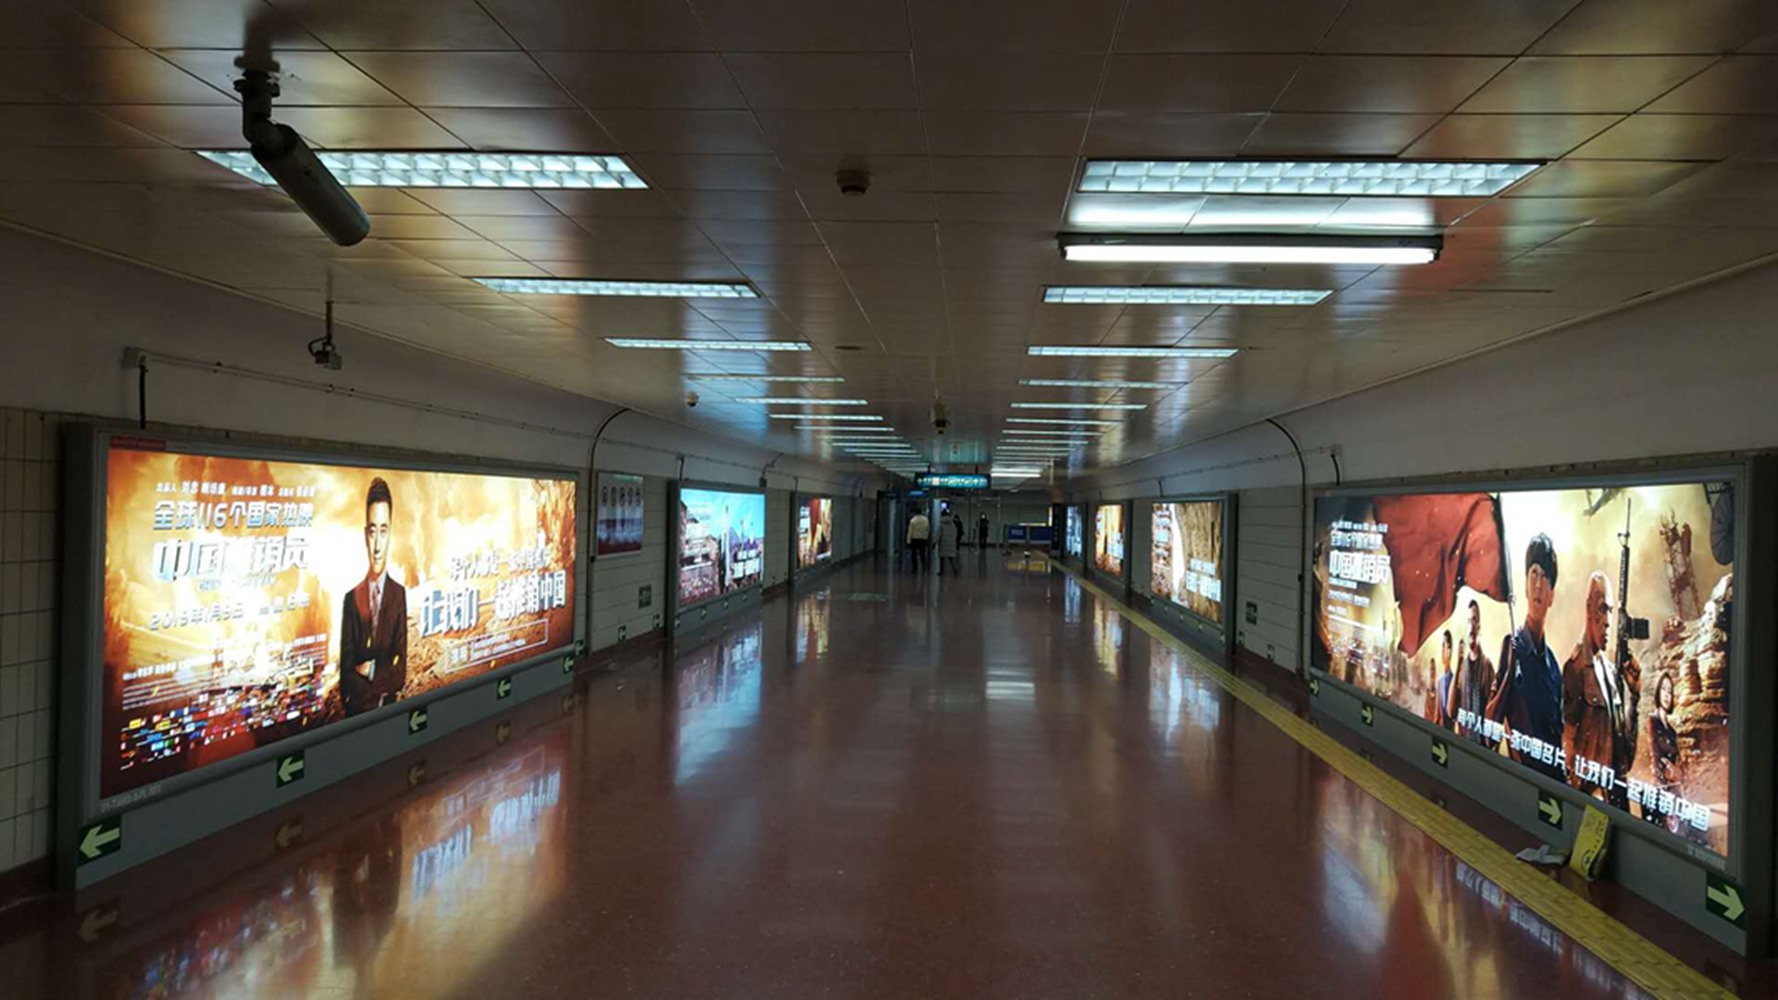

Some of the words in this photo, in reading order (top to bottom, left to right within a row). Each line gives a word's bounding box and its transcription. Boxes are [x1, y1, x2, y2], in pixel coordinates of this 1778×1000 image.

[153, 500, 314, 530] 全球116个国家热映
[152, 536, 309, 582] 中国销员
